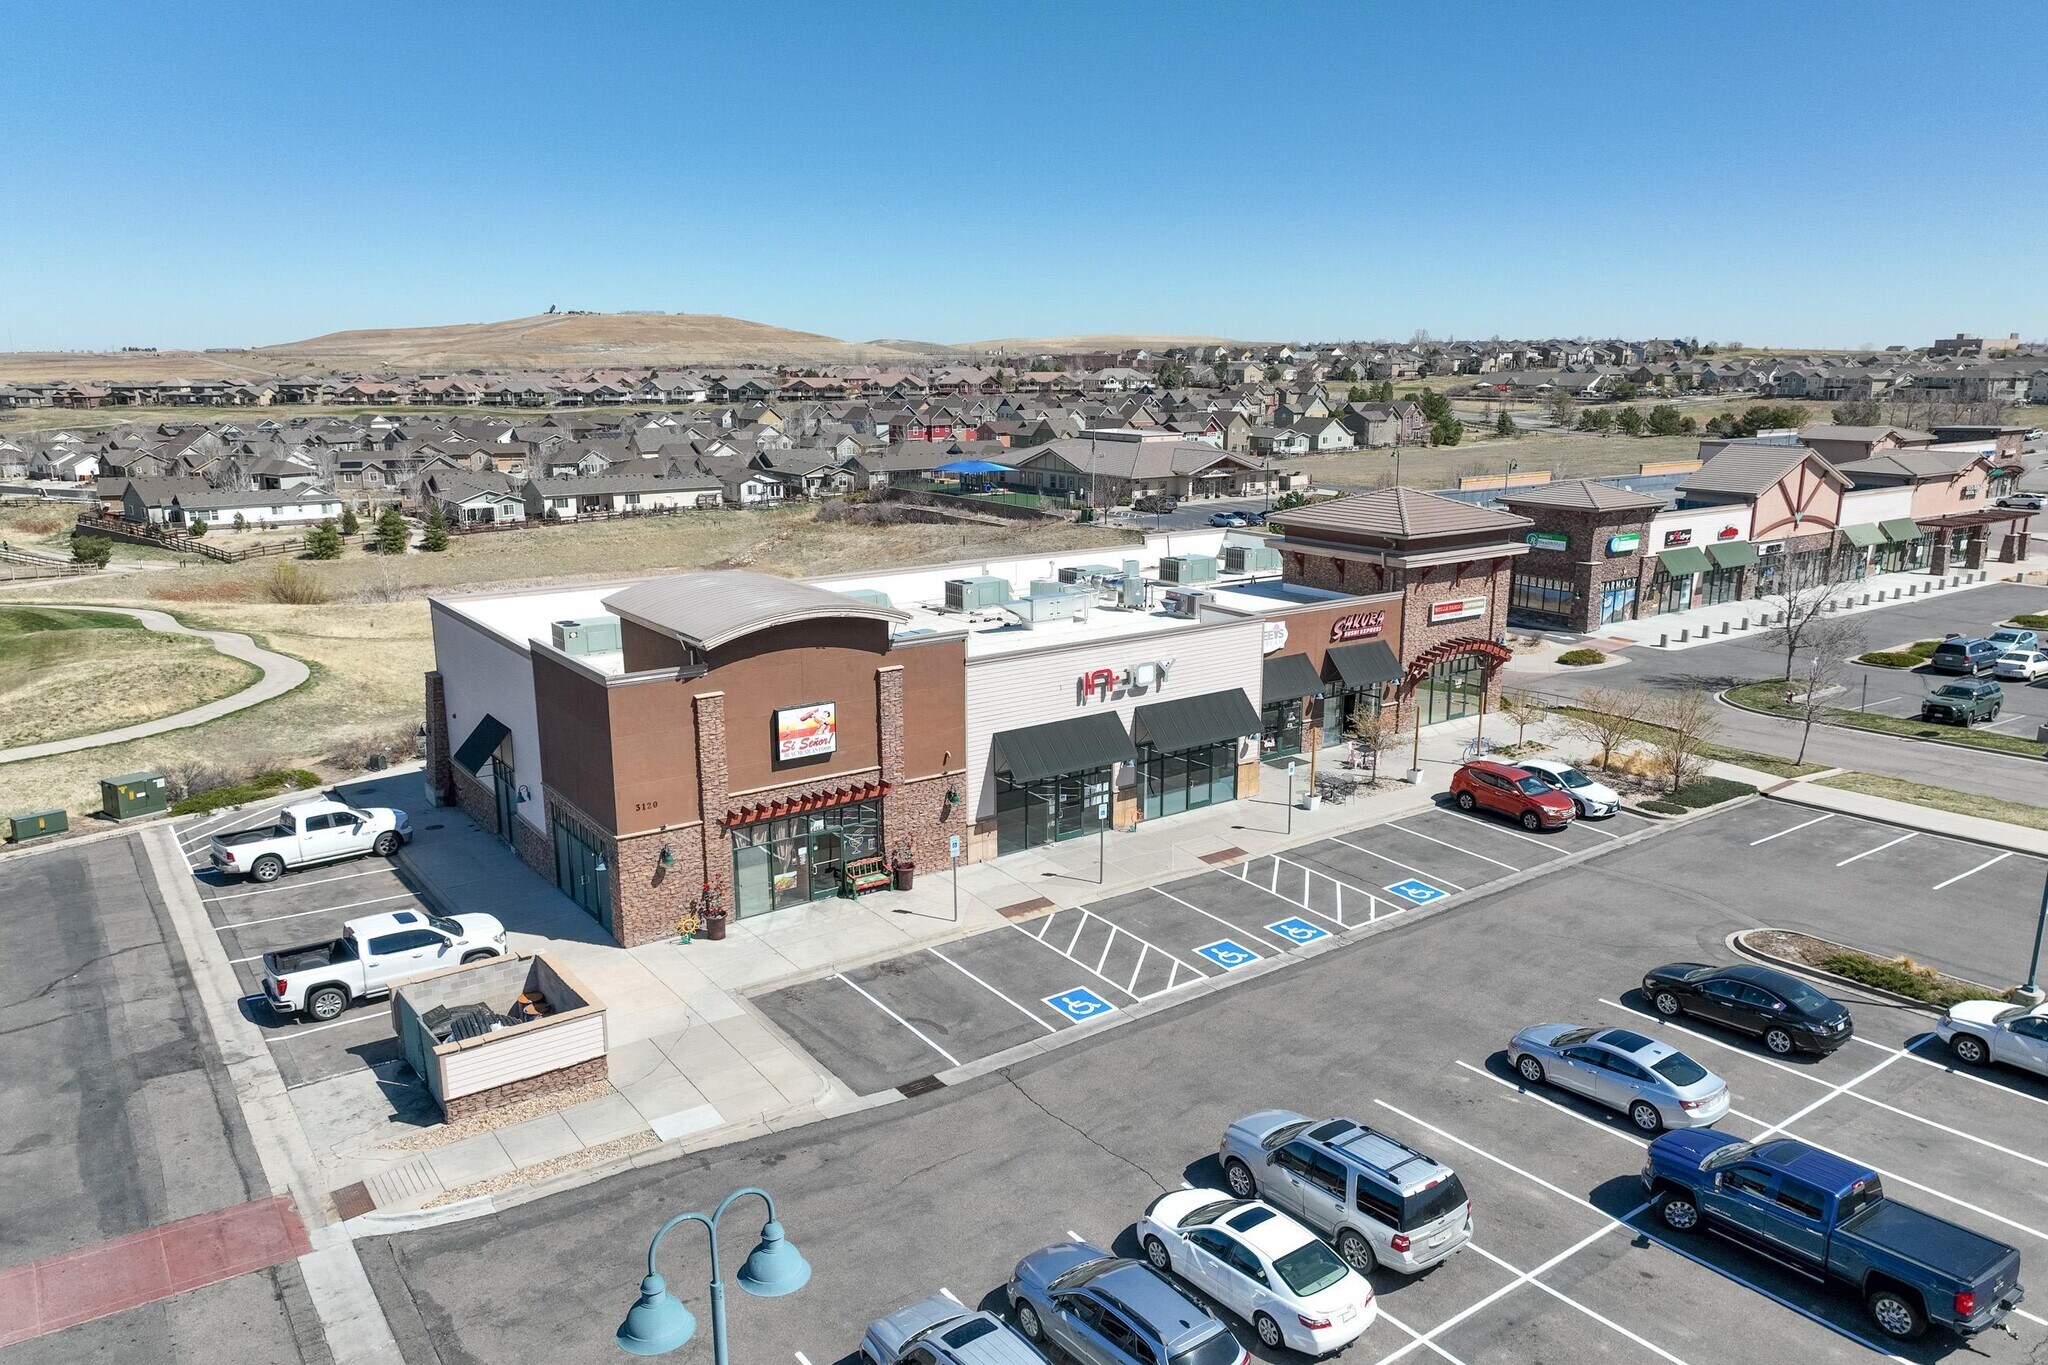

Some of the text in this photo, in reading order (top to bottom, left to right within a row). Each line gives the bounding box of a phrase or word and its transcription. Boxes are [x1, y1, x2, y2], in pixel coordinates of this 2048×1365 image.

[1600, 578, 1638, 591] HARMACY
[1331, 610, 1386, 640] SAKURA
[1344, 626, 1383, 638] SUSHI EXPRESS
[635, 801, 658, 812] 3120
